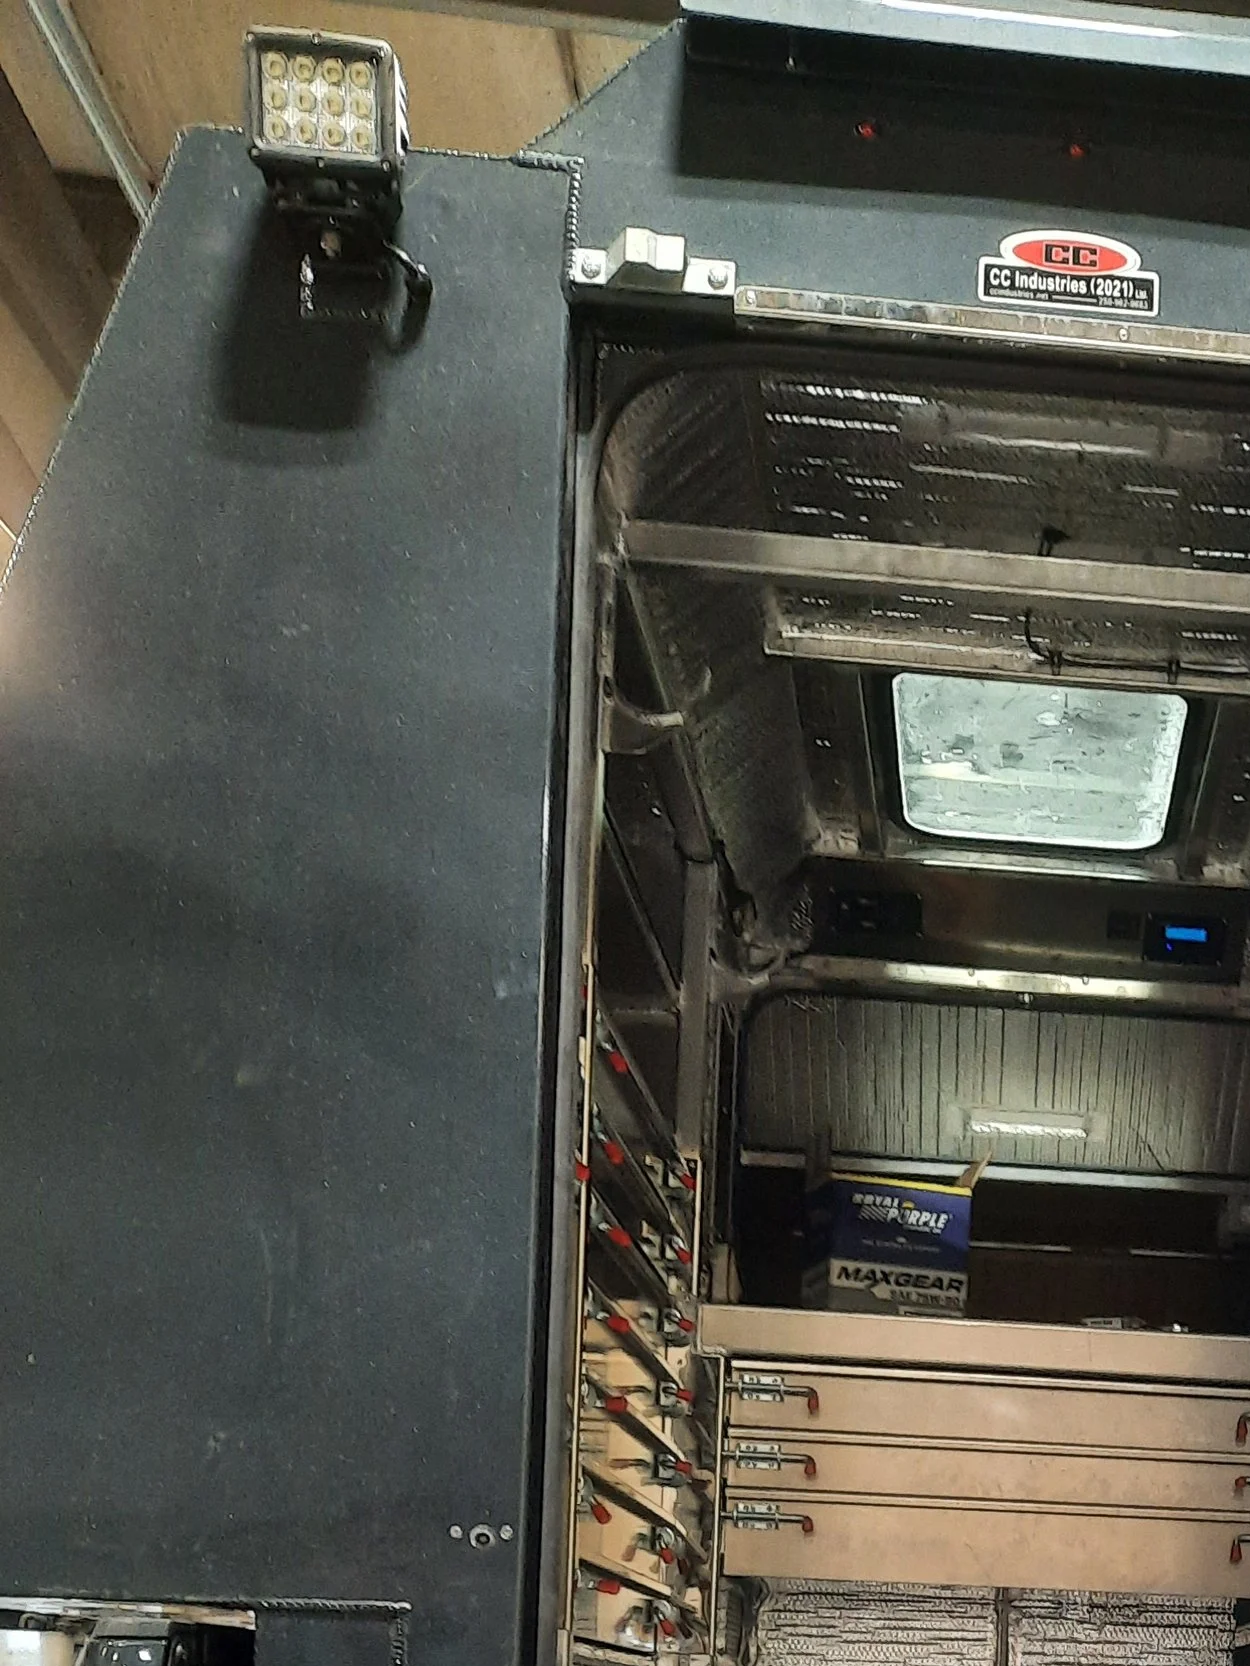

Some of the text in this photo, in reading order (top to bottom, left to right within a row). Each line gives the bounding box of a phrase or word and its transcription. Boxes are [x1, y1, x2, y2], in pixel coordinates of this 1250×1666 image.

[1044, 244, 1098, 268] CC
[989, 268, 1011, 287] CC
[1015, 271, 1088, 294] Industries
[1090, 276, 1134, 298] (2021)
[852, 1193, 899, 1208] ROYAL
[886, 1207, 949, 1229] PURPLE
[836, 1265, 964, 1294] MAXGEAR
